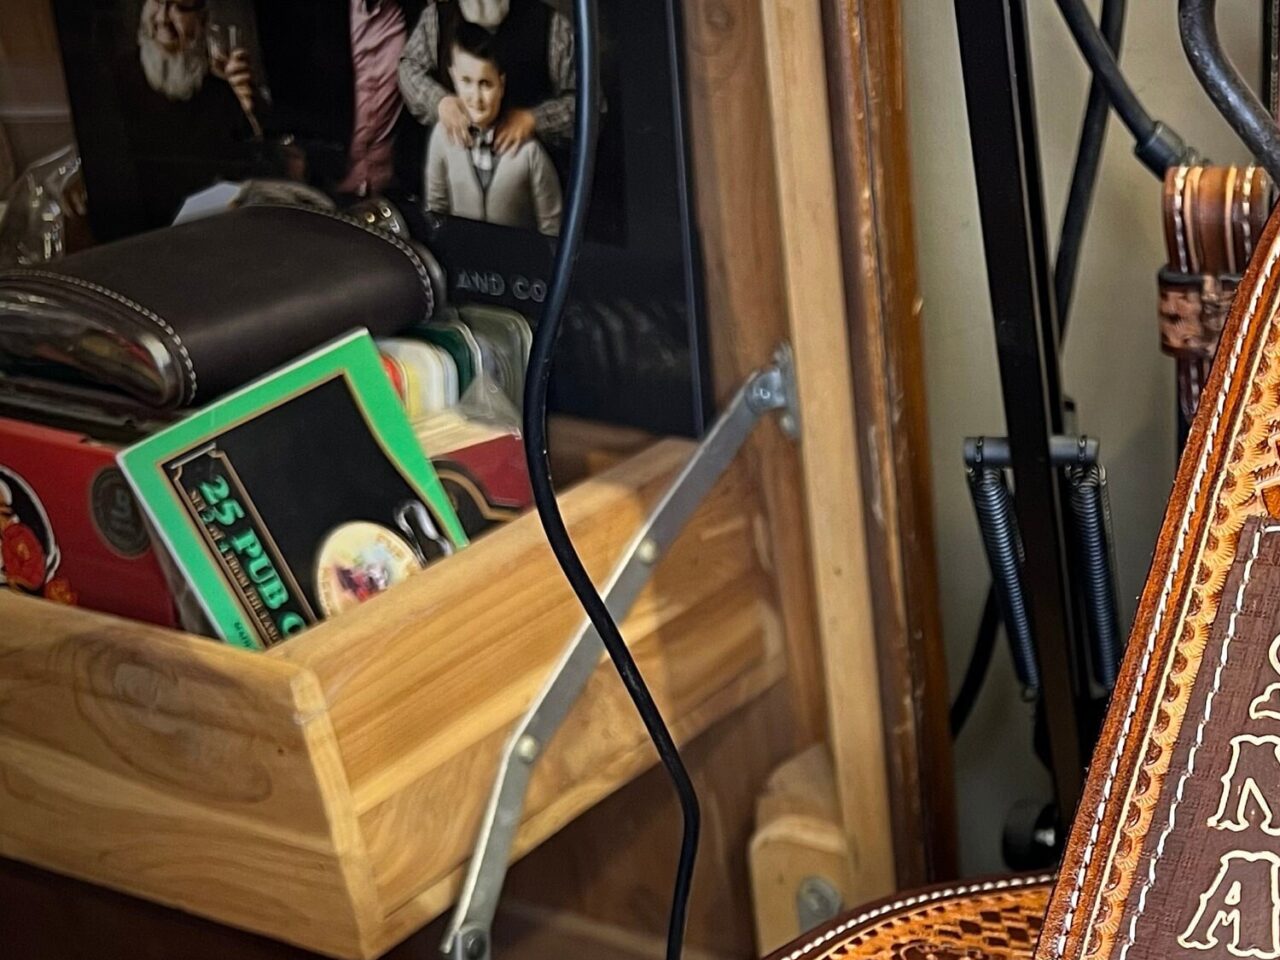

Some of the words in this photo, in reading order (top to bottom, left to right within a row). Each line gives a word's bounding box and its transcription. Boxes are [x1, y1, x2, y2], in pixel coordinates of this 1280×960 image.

[456, 269, 506, 297] AND
[201, 474, 245, 526] 25
[231, 527, 290, 610] PUB
